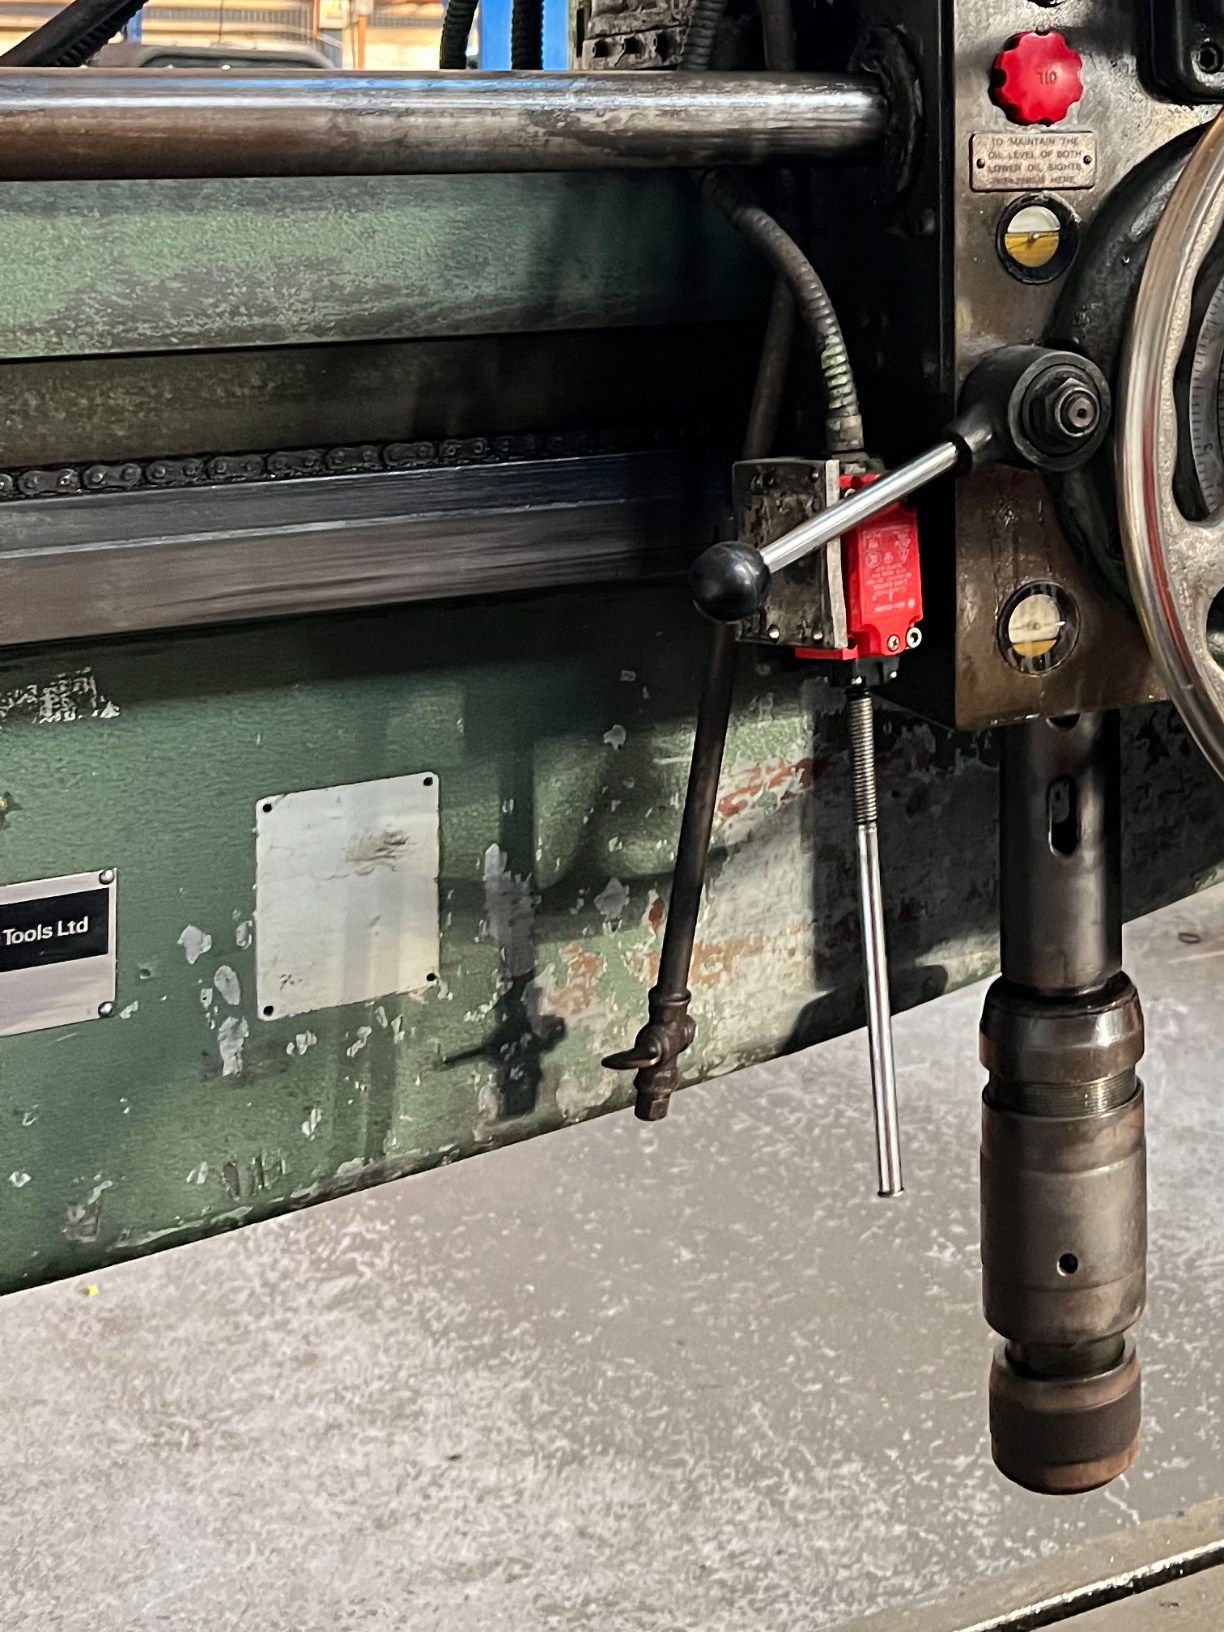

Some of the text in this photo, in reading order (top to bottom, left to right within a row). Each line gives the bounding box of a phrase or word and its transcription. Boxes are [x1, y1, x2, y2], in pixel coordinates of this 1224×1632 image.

[1037, 70, 1057, 85] OIL
[992, 137, 1079, 146] TO MAINTAIN THE
[1008, 151, 1034, 160] LEVEL
[1041, 150, 1053, 159] OF
[1057, 150, 1082, 159] BOTH
[1203, 442, 1213, 452] 3
[2, 915, 89, 946] Tools Ltd
